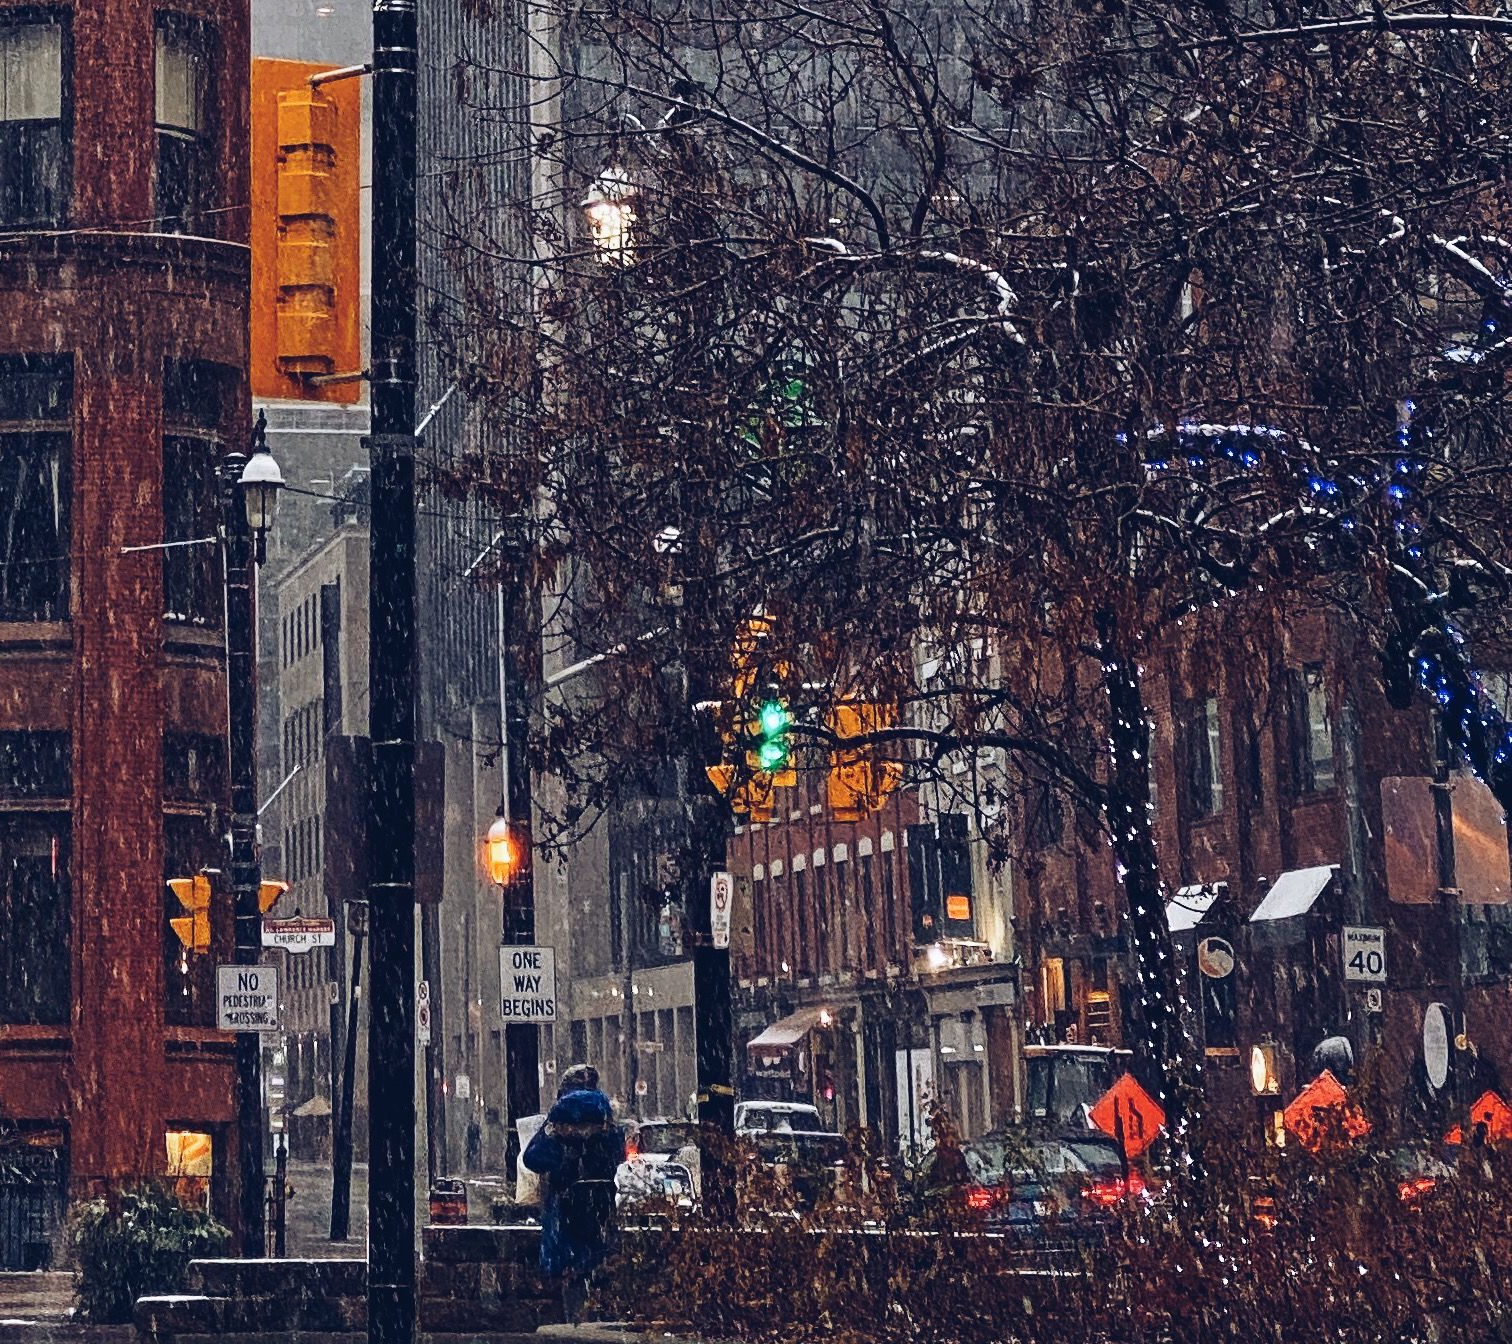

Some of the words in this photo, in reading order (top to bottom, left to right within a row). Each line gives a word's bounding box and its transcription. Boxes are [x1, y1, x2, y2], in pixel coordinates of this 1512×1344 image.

[274, 934, 306, 944] CHURCH
[512, 951, 541, 969] ONE
[1348, 950, 1383, 974] 40
[238, 973, 259, 991] NO
[513, 975, 541, 993] WAY
[503, 998, 554, 1017] BEGINS
